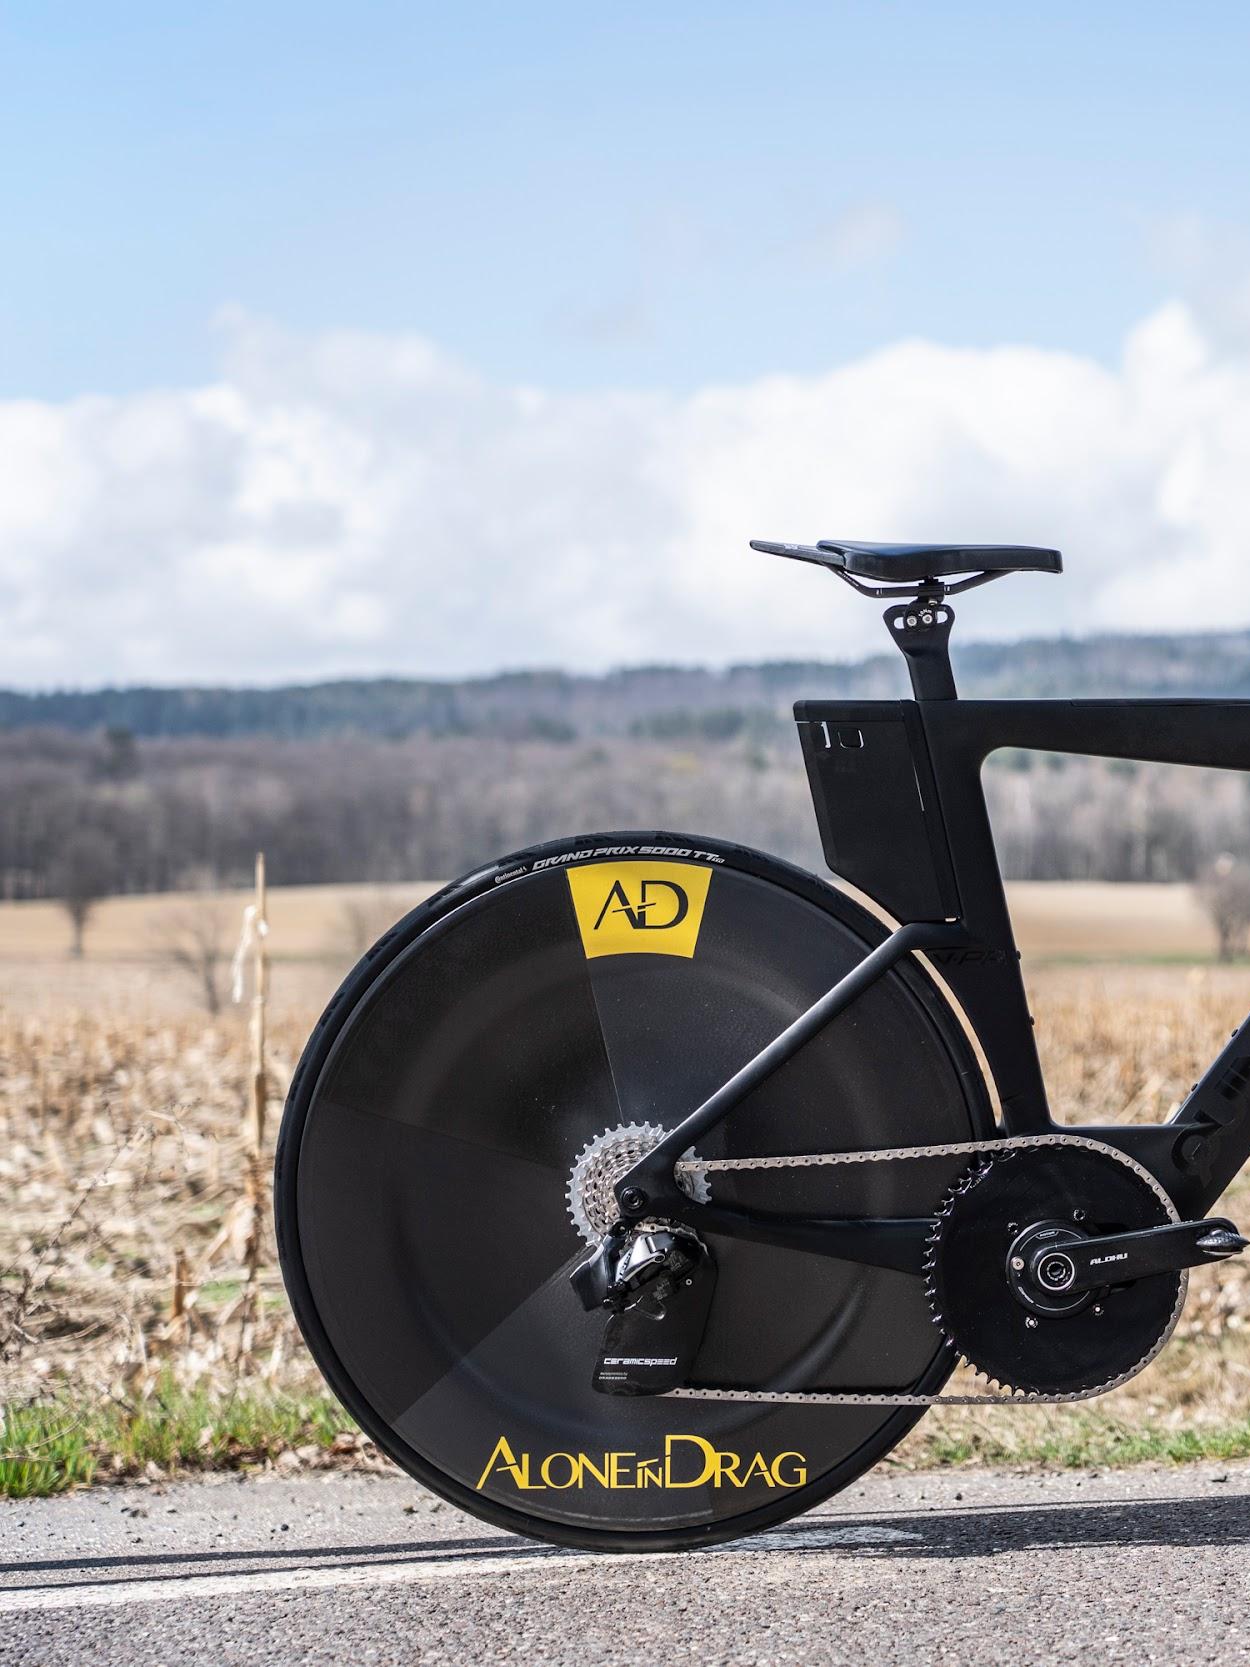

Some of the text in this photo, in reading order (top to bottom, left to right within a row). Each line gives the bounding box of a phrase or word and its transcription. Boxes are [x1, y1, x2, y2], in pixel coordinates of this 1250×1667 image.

[532, 848, 592, 871] GRAND
[592, 845, 640, 857] PRIX
[638, 846, 692, 857] 5000
